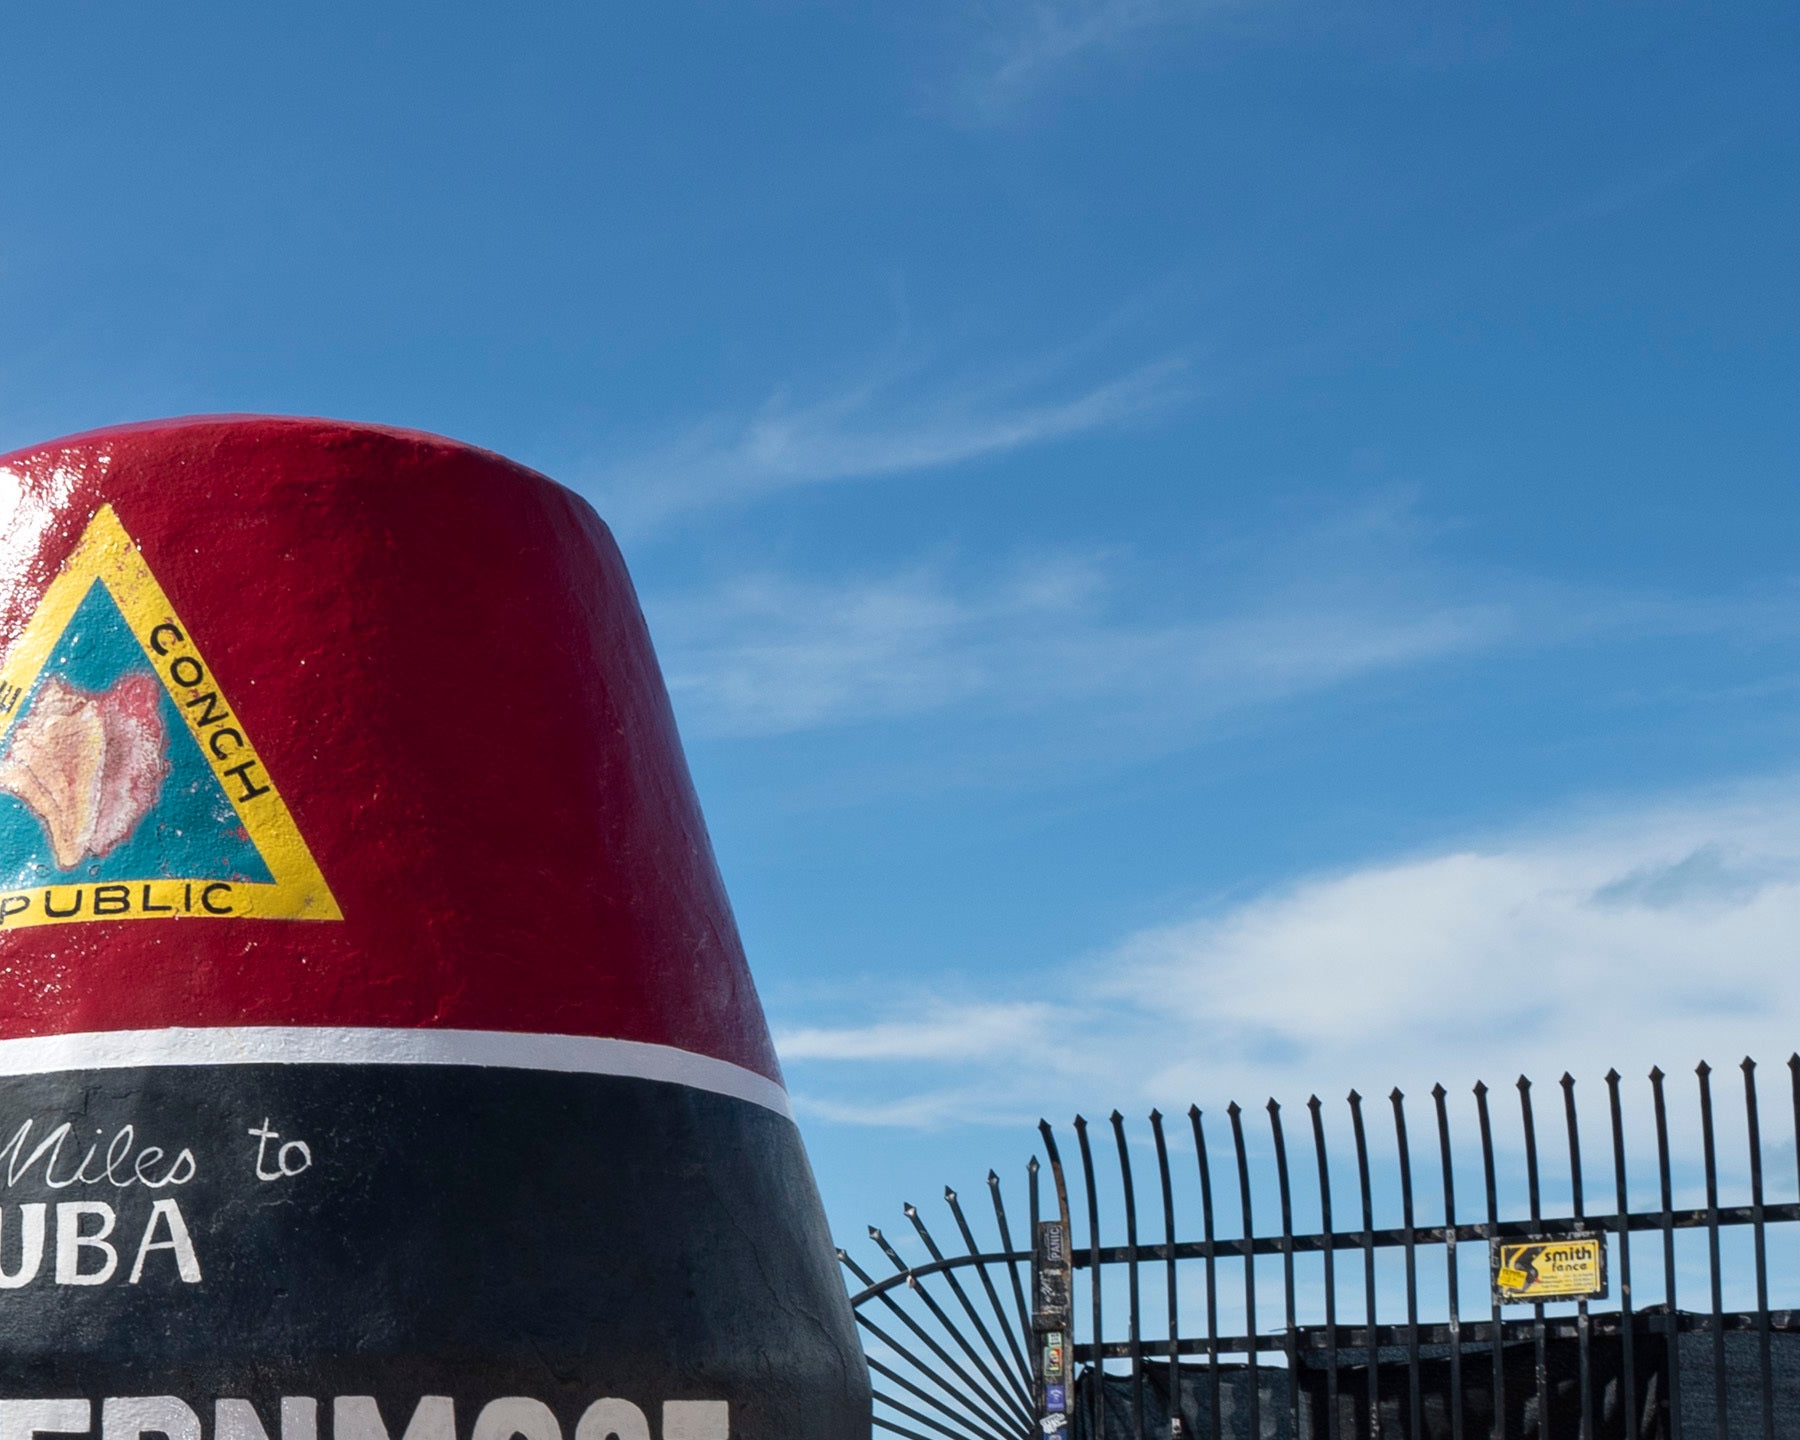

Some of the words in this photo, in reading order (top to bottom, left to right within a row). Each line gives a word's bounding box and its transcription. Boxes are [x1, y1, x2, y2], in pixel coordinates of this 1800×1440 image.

[150, 623, 270, 804] CONCH
[247, 1117, 312, 1181] to
[1544, 1246, 1593, 1263] smith
